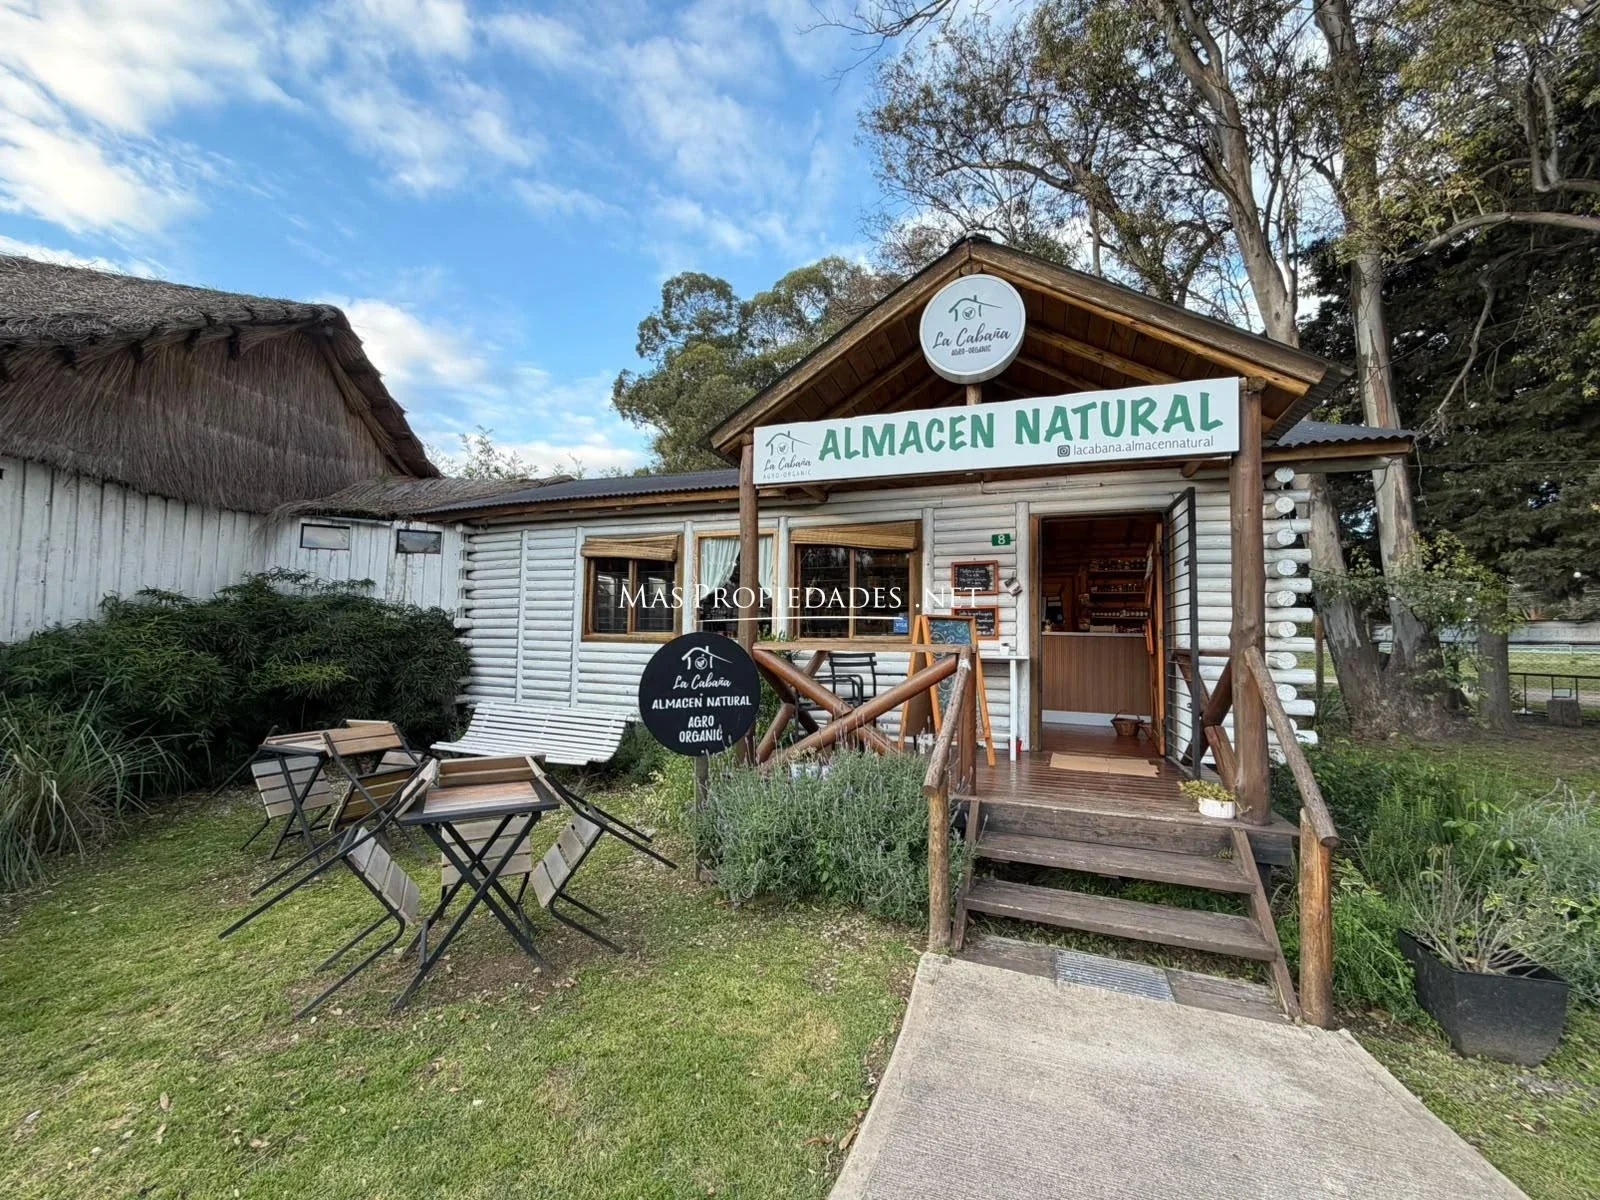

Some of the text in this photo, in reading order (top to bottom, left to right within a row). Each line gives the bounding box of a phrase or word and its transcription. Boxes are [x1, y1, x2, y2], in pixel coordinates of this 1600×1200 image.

[932, 323, 1011, 349] La Cabaña
[818, 392, 1223, 461] ALMACEN NATURAL
[1073, 436, 1214, 456] lacabana.almacennatural
[764, 454, 812, 472] La Cabaña
[998, 534, 1006, 545] 8
[672, 672, 732, 690] La Cabaña
[652, 695, 752, 710] ALMACEN NATURAL
[688, 715, 715, 728] AGRO
[679, 729, 723, 743] ORGANIC
